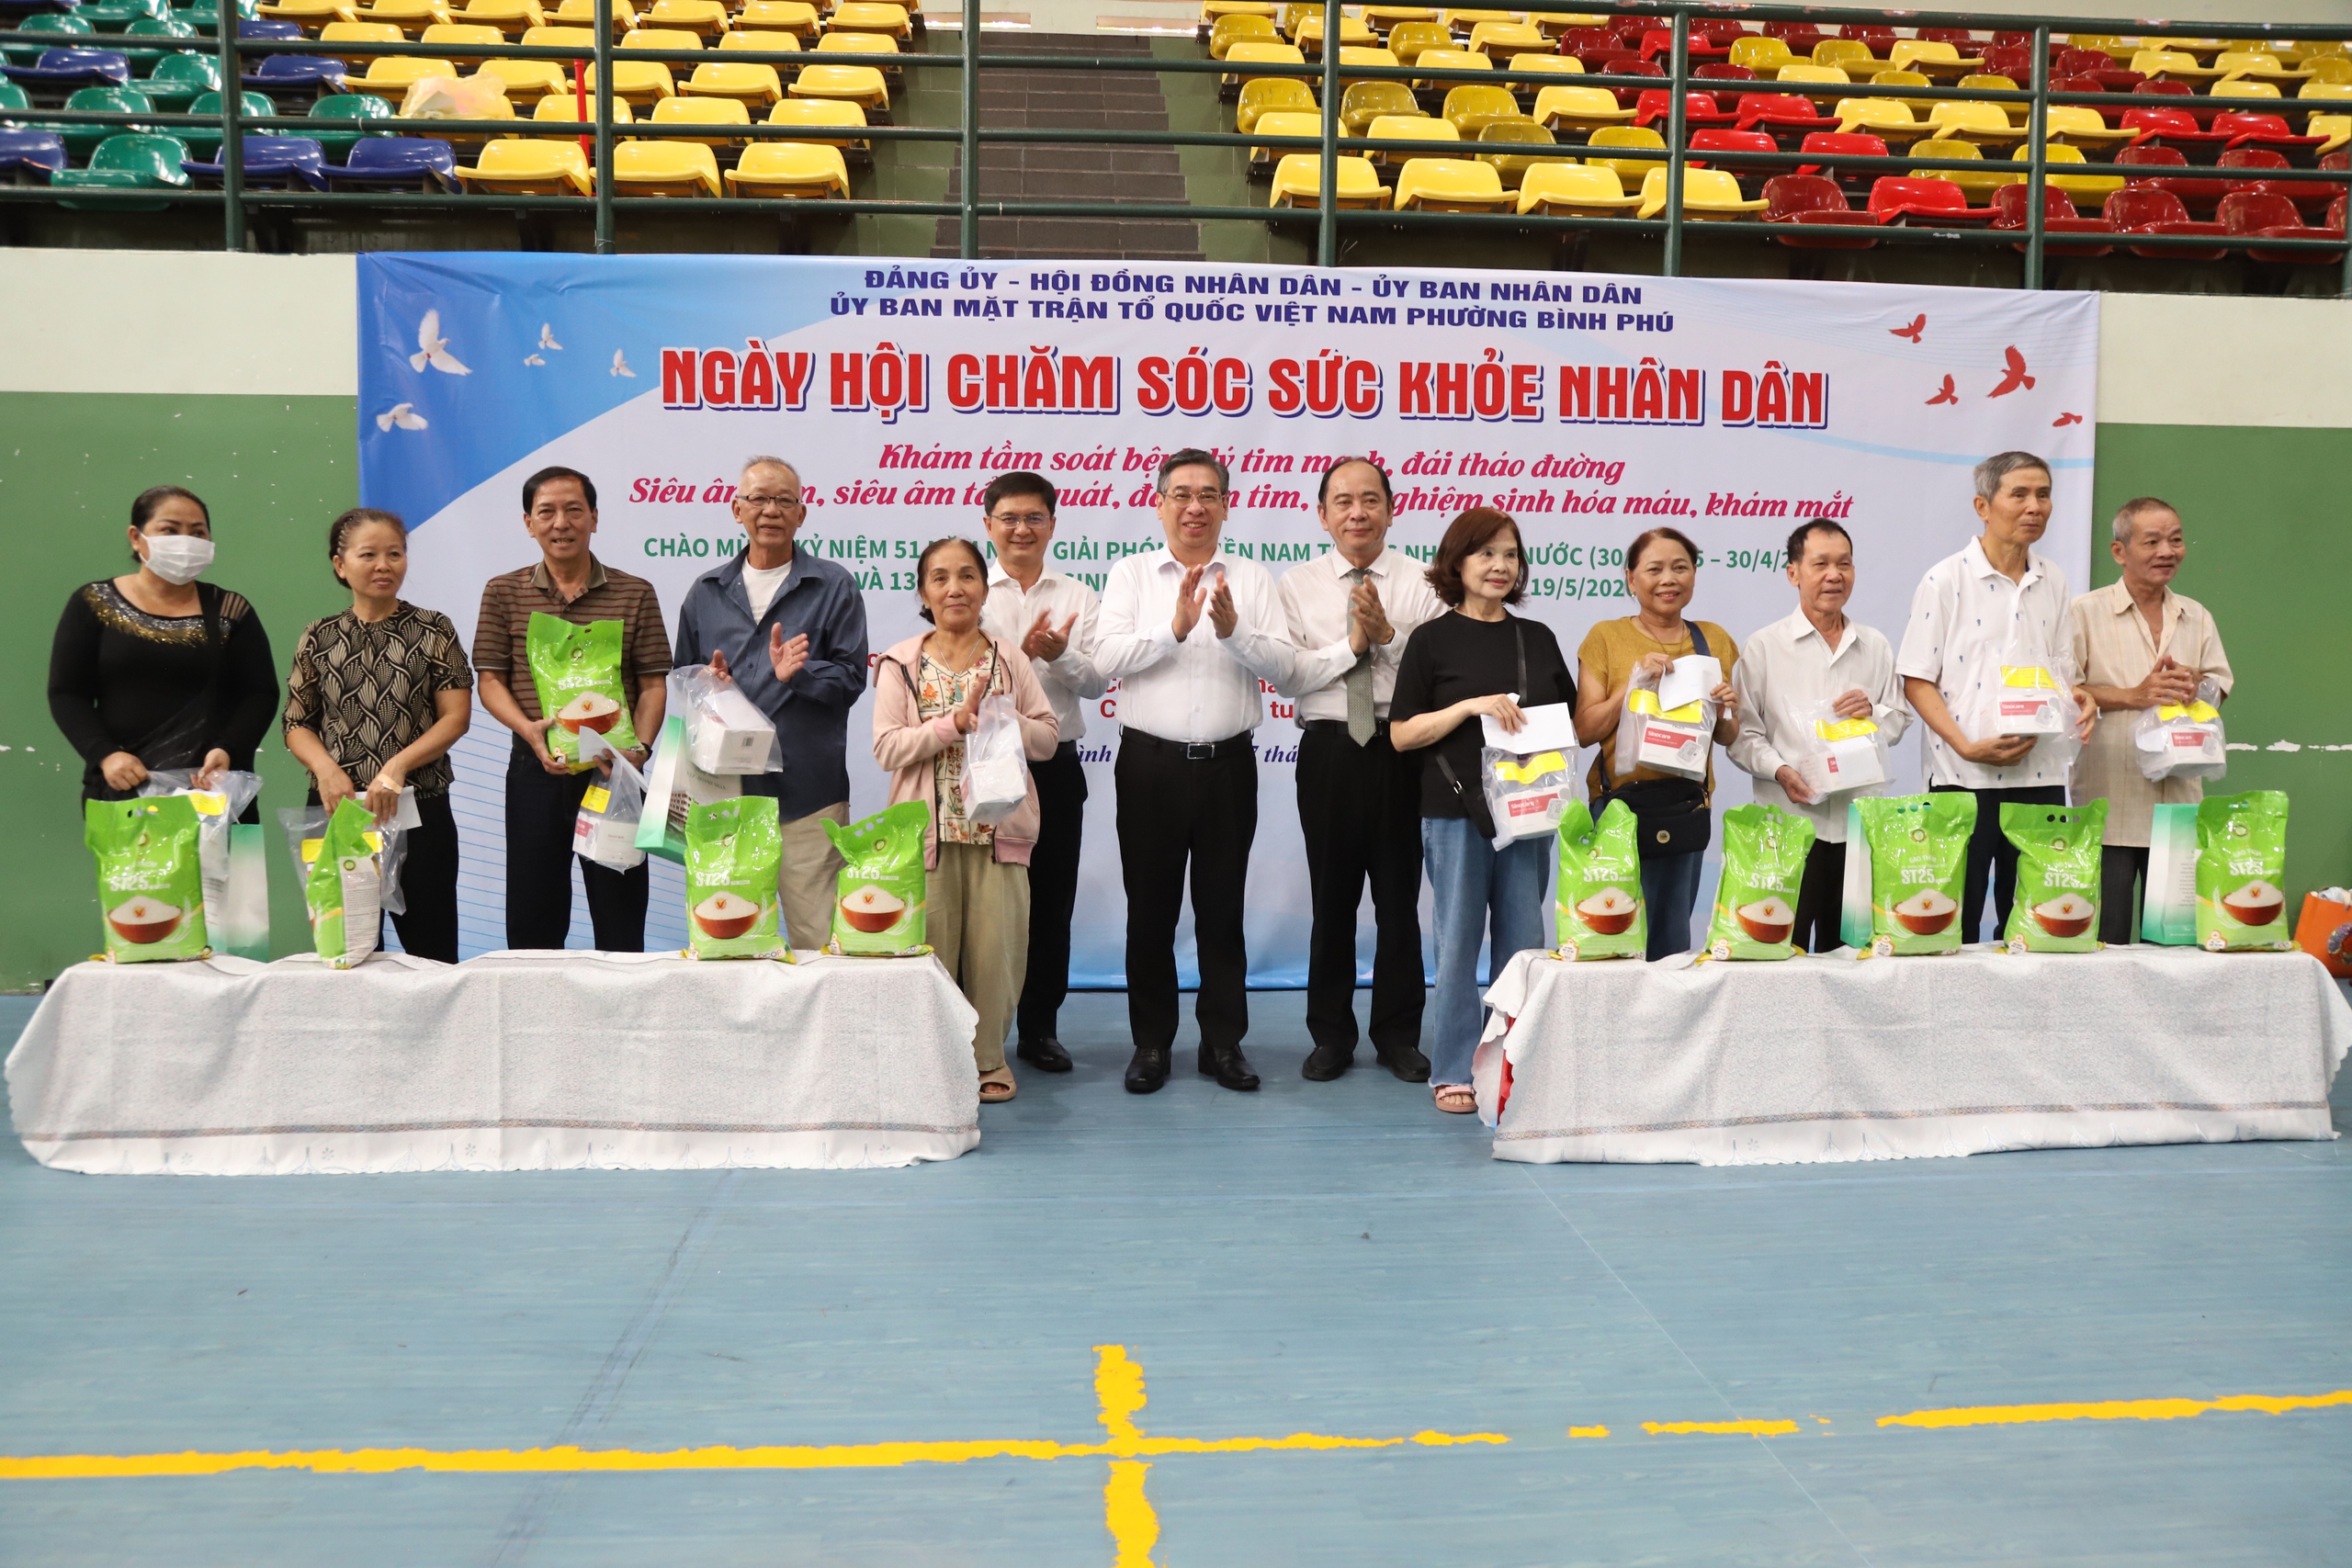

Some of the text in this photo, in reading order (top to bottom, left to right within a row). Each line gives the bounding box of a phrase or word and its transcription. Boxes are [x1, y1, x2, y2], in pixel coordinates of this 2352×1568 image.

[865, 265, 949, 290] ĐẢNG
[960, 265, 999, 291] ỦY
[1031, 269, 1080, 295] HỘI
[1091, 268, 1174, 294] ĐỒNG
[1185, 273, 1269, 295] NHÂN
[1280, 275, 1341, 297] DÂN
[1373, 274, 1410, 298] ỦY
[1420, 280, 1481, 301] BAN
[1491, 279, 1572, 304] NHÂN
[1583, 281, 1642, 305] DÂN
[831, 291, 1675, 333] ỦY BAN MẶT TRẬN TỔ QUỐC VIỆT NAM PHƯỜNG BÌNH PHÚ
[661, 336, 1829, 430] NGÀY HỘI CHĂM SÓC SỨC KHỎE NHÂN DÂN
[878, 442, 973, 470] Khám
[979, 439, 1041, 470] tầm
[1050, 444, 1117, 472] soát
[1240, 447, 1295, 473] tim
[1401, 449, 1453, 476] đái
[1457, 450, 1525, 478] tháo
[1531, 452, 1626, 486] đường
[628, 477, 696, 503] Siêu
[832, 479, 898, 505] siêu
[903, 479, 956, 505] âm
[1055, 480, 1121, 510] uát,
[1247, 483, 1309, 512] tim,
[1392, 486, 1484, 518] ghiệm
[1490, 487, 1555, 513] sinh
[1561, 489, 1617, 514] hóa
[1623, 489, 1698, 518] máu,
[1704, 491, 1788, 517] khám
[1793, 490, 1854, 519] mắt
[644, 532, 709, 558] CHÀO
[830, 535, 887, 565] NIỆM
[894, 540, 920, 559] 51
[1053, 536, 1099, 560] GIẢI
[1261, 543, 1310, 562] NAM
[1521, 541, 1583, 566] NƯỚC
[854, 566, 884, 591] VÀ
[1901, 868, 1936, 885] ST25
[2044, 872, 2080, 888] ST25
